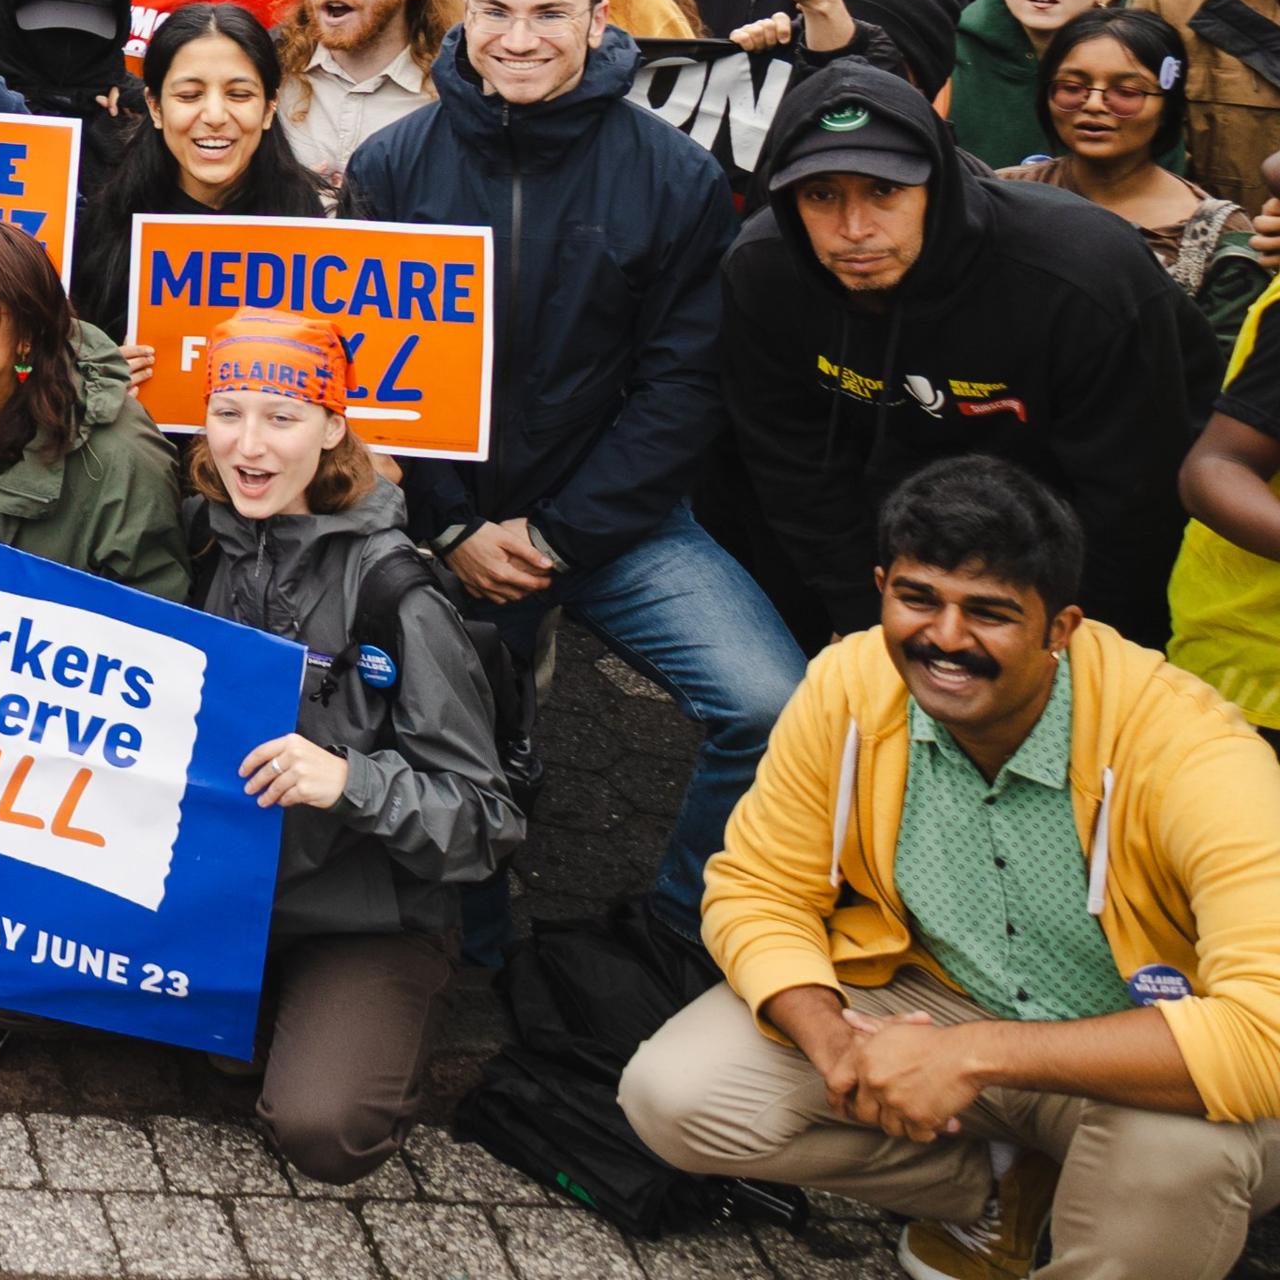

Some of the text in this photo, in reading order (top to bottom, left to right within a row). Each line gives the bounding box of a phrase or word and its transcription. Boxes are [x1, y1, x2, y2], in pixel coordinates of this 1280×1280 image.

[148, 248, 476, 324] MEDICARE
[218, 360, 309, 389] CLAIRE
[31, 930, 130, 985] JUNE
[139, 963, 190, 998] 23
[1135, 982, 1188, 995] VALDEZ
[1138, 973, 1185, 986] CLAIRE
